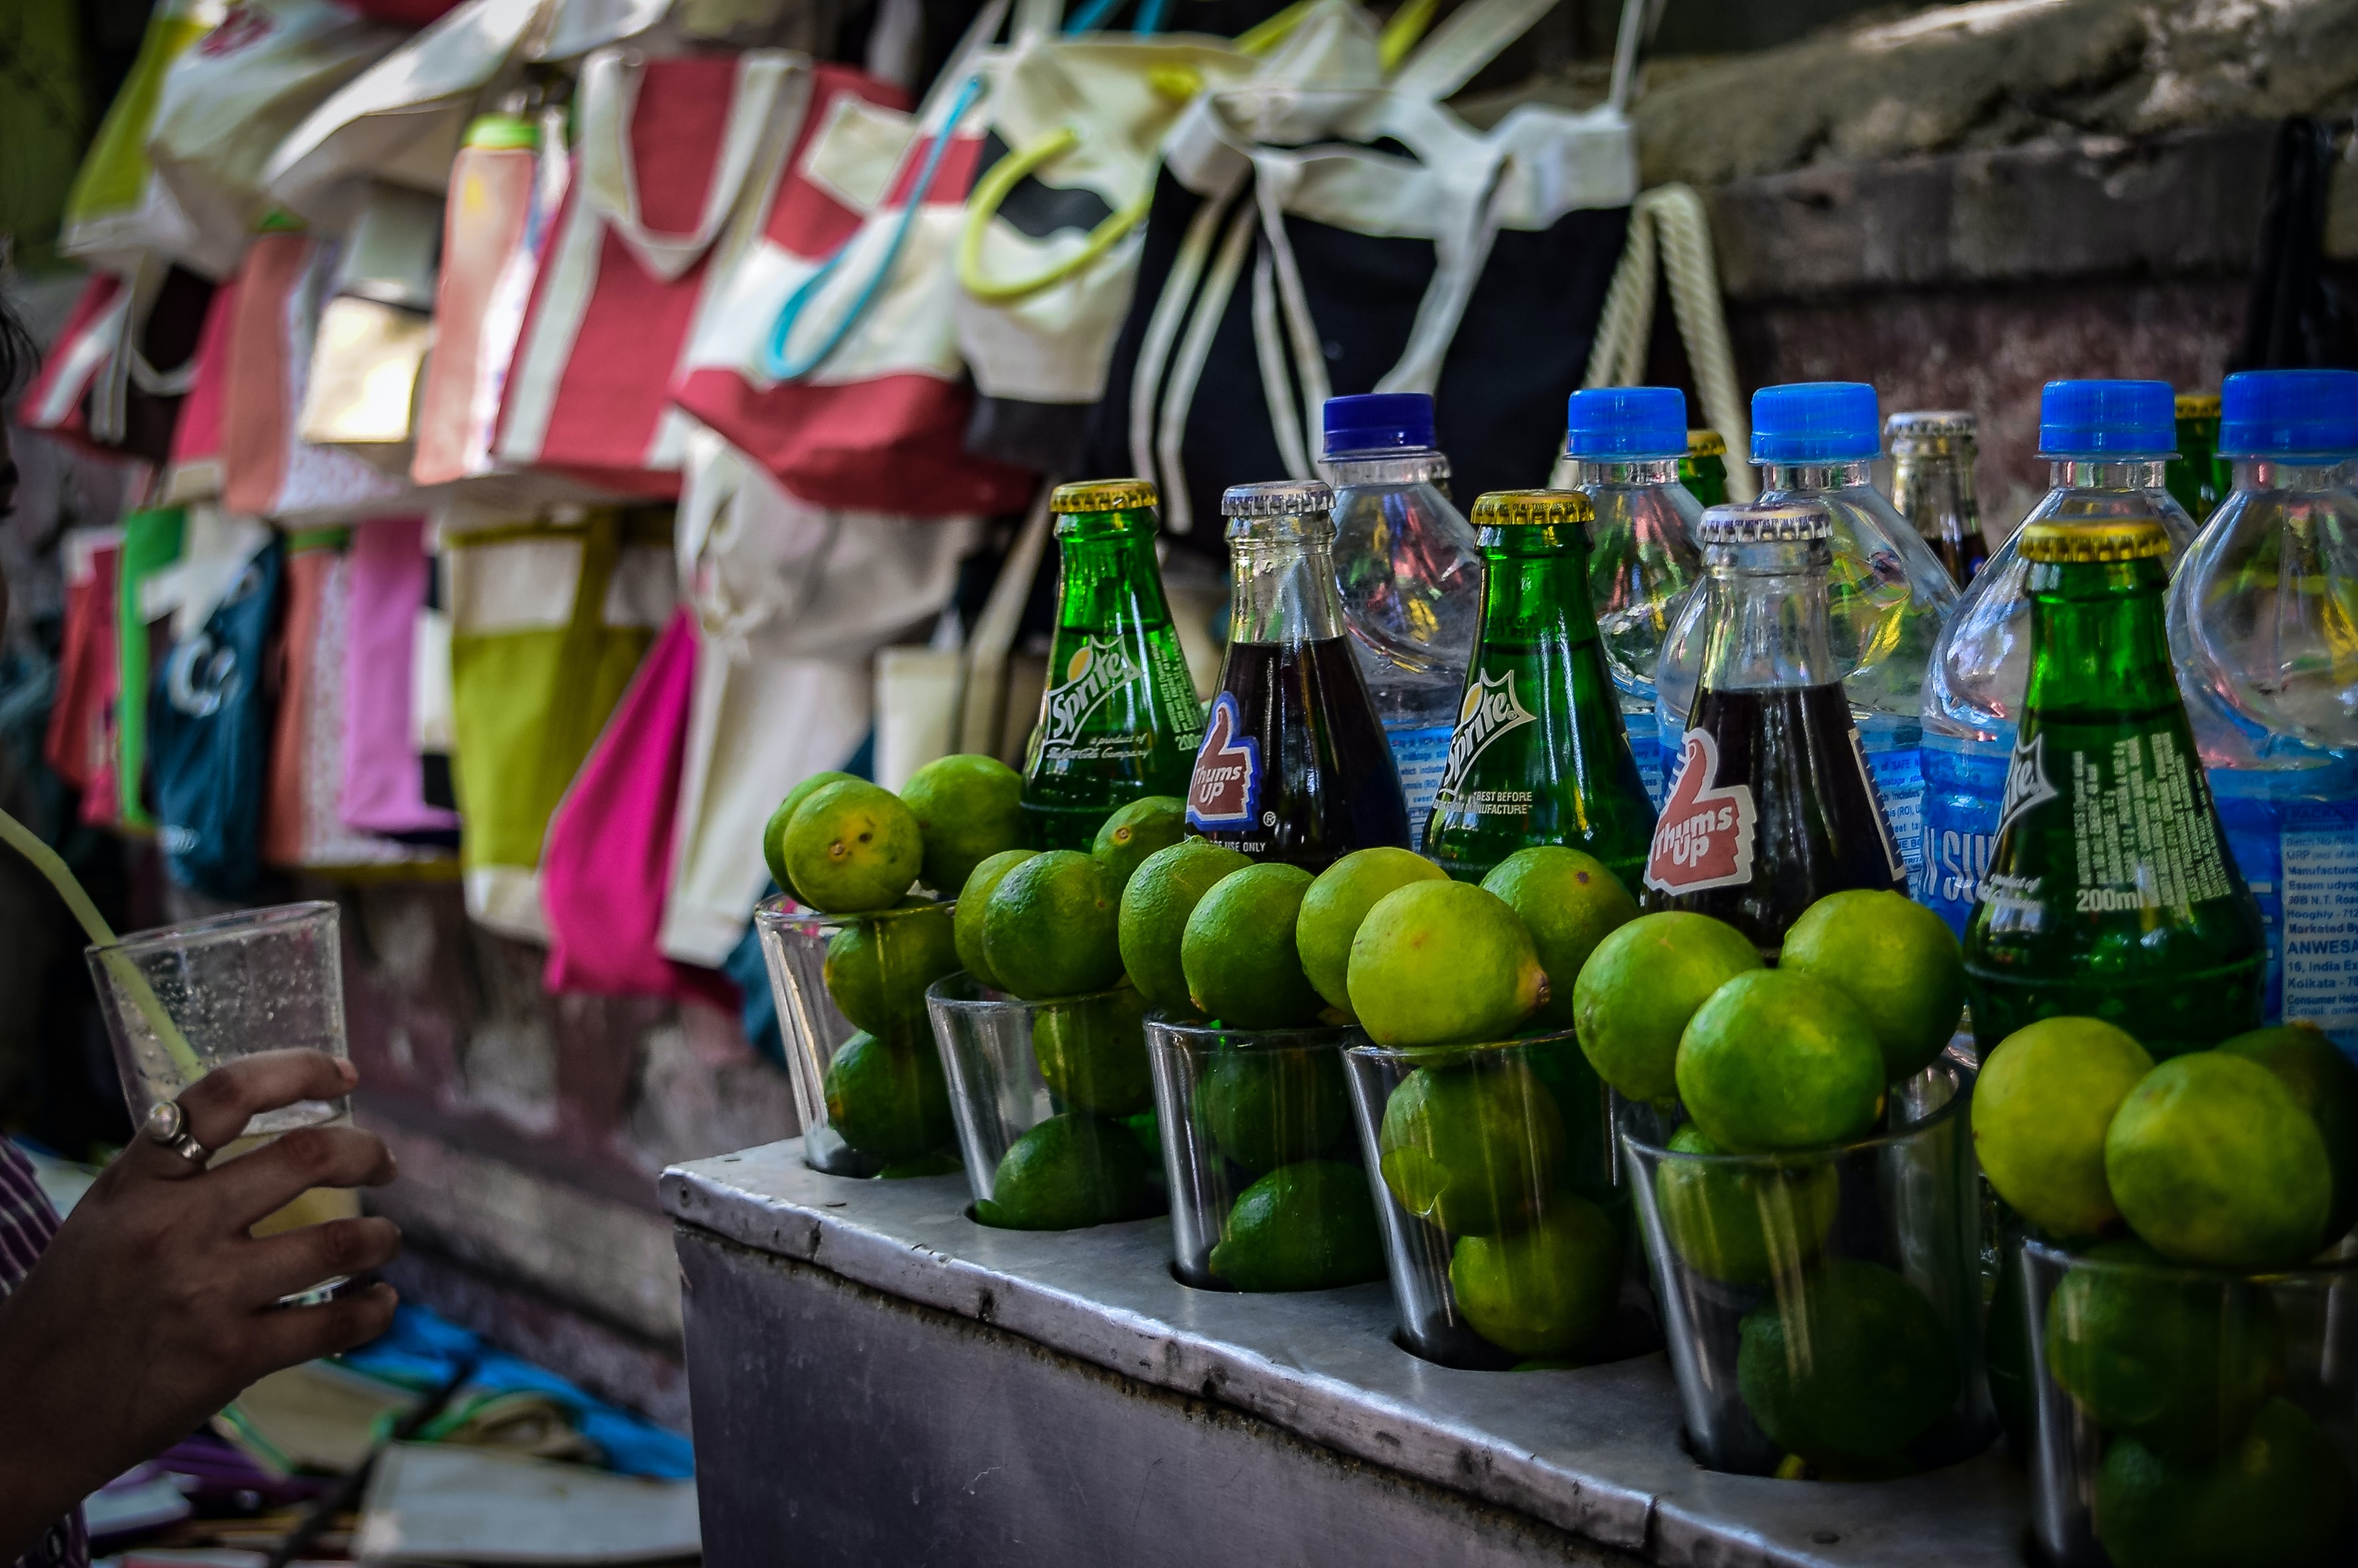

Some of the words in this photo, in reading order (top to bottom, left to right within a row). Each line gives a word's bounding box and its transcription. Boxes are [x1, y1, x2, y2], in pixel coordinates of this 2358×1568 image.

[1443, 688, 1511, 787] Sprite
[1892, 761, 1910, 771] SAFE
[1497, 791, 1532, 802] BEFORE
[1892, 790, 1920, 800] includes
[1243, 841, 1266, 853] ONLY
[2076, 888, 2144, 913] 200ml
[2309, 961, 2340, 972] India
[2287, 977, 2336, 988] Kolkata
